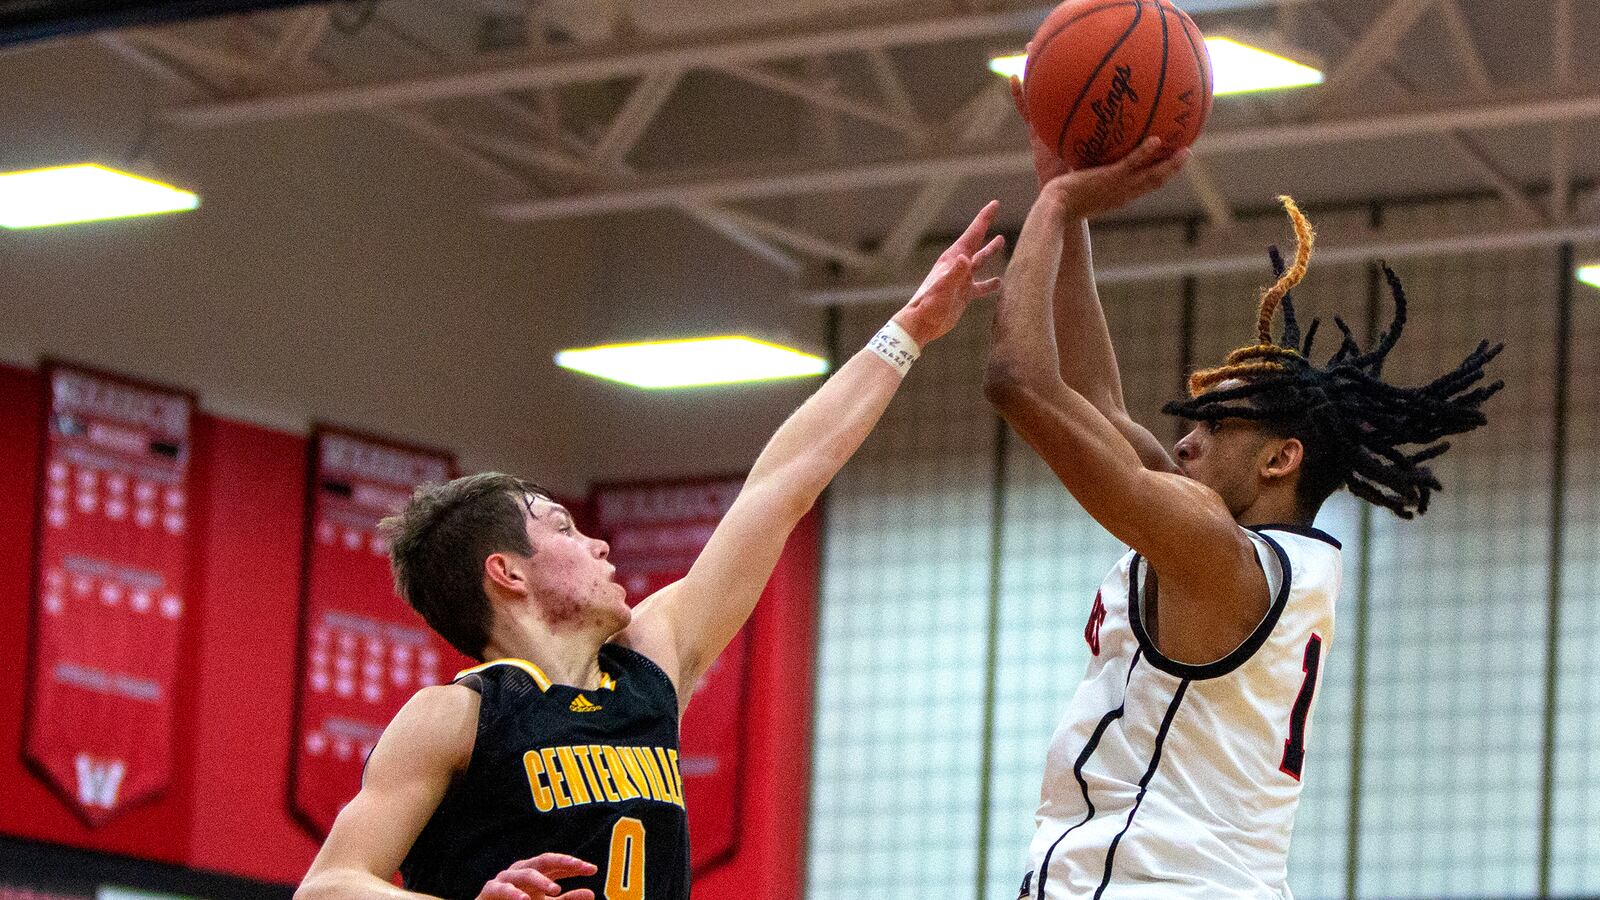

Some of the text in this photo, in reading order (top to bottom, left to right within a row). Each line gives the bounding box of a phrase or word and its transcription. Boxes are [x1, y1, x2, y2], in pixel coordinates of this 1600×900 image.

[1073, 64, 1138, 167] Rawlings
[1279, 632, 1322, 782] 1
[76, 754, 124, 808] W
[522, 744, 686, 813] CENTERVILLE
[604, 816, 646, 900] 0
